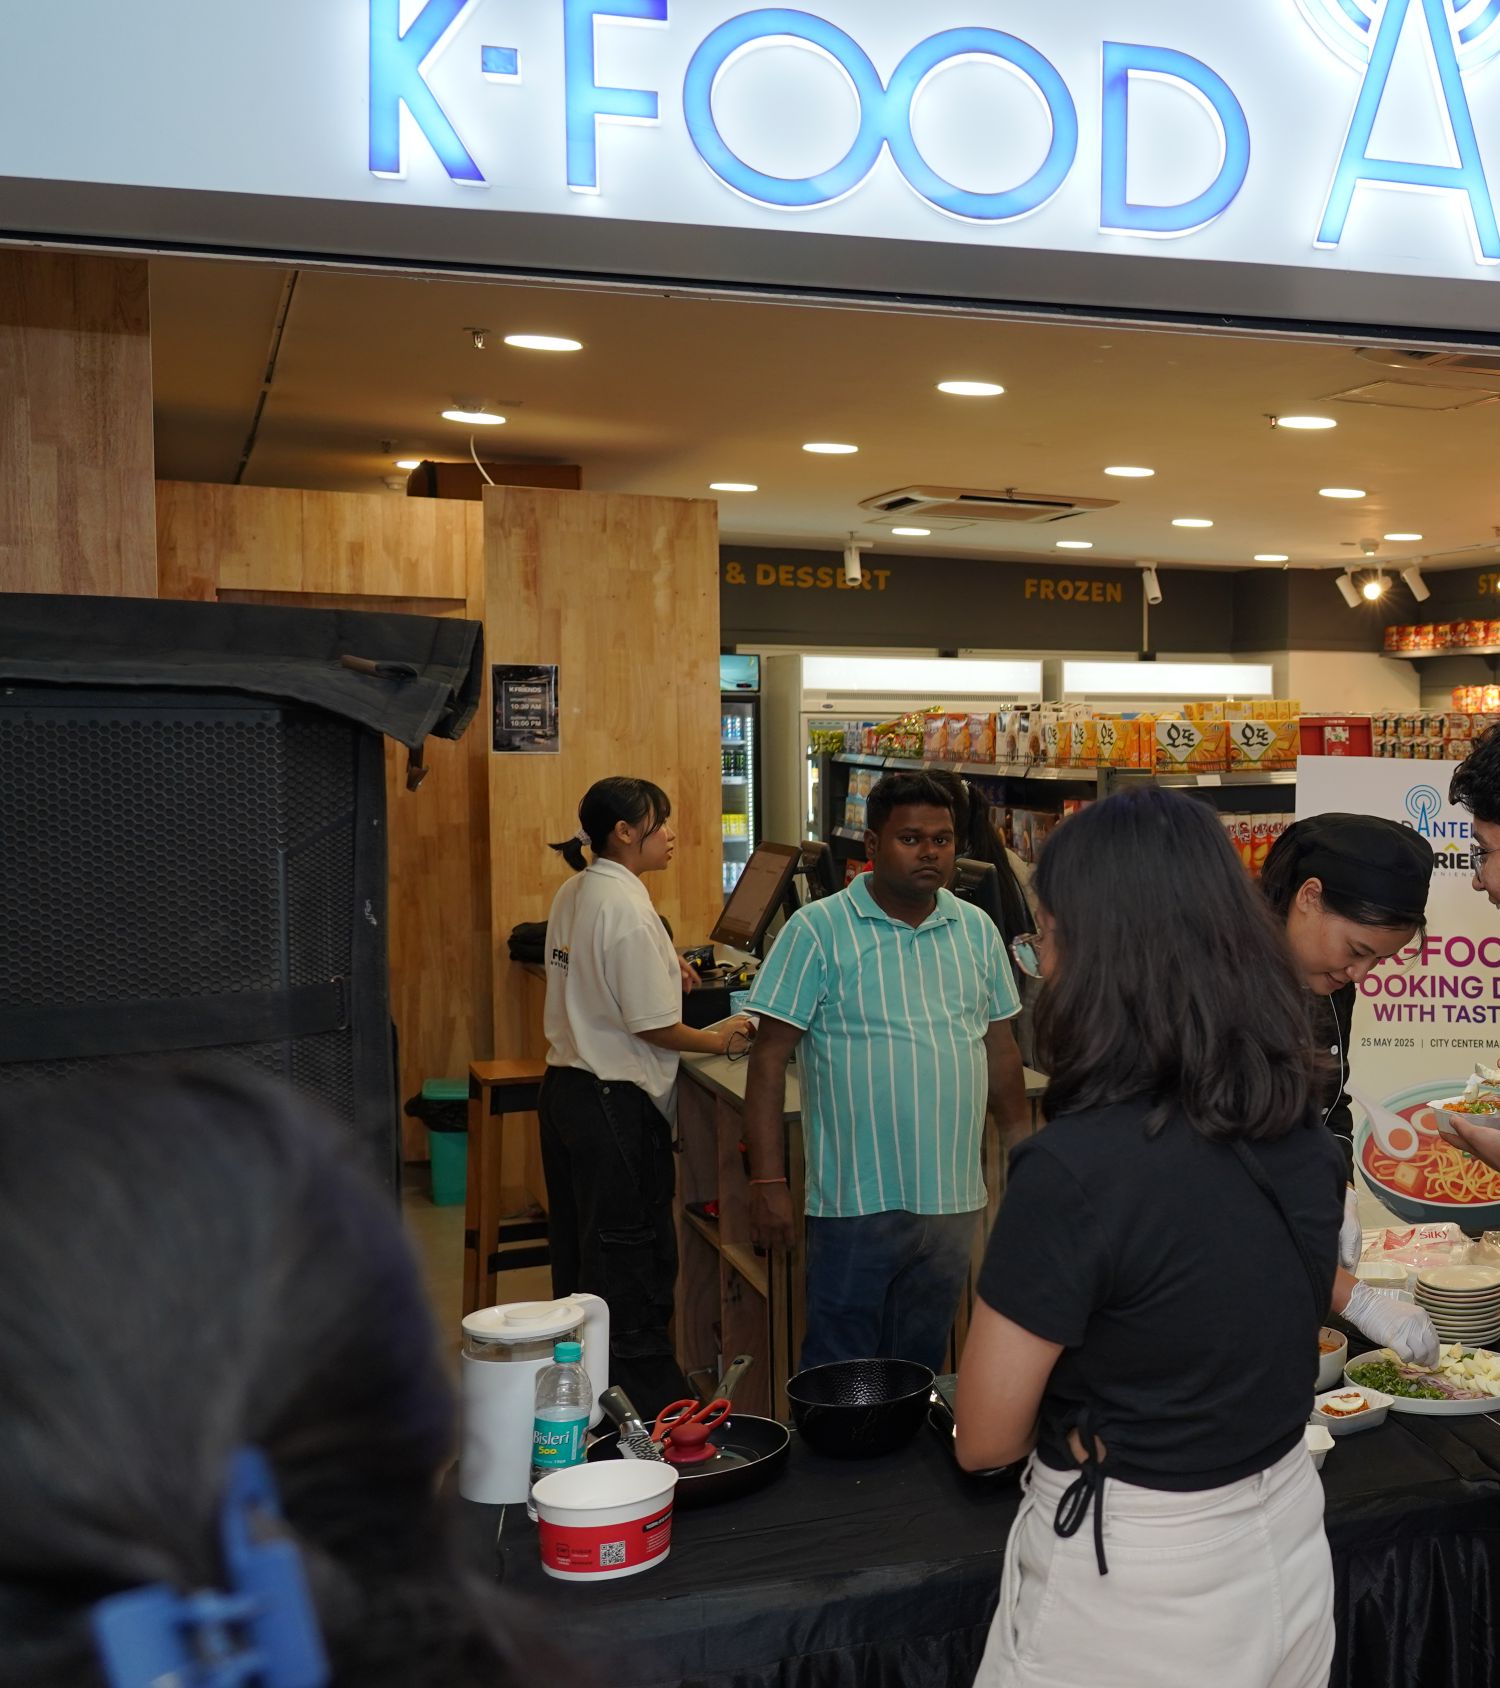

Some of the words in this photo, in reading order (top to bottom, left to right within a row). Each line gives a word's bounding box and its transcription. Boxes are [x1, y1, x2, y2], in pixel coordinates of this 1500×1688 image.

[368, 0, 1251, 238] K-FOOD
[725, 561, 746, 585] &
[1024, 578, 1122, 602] FROZEN
[1358, 974, 1484, 999] OOKING
[1373, 1003, 1436, 1023] WITH
[1361, 1038, 1372, 1047] 25
[1373, 1038, 1392, 1047] MAY
[1394, 1038, 1415, 1047] 2025
[1430, 1038, 1449, 1048] CITY
[1451, 1039, 1484, 1049] CENTER
[1420, 1230, 1450, 1239] Silky
[534, 1430, 570, 1445] Bisleri
